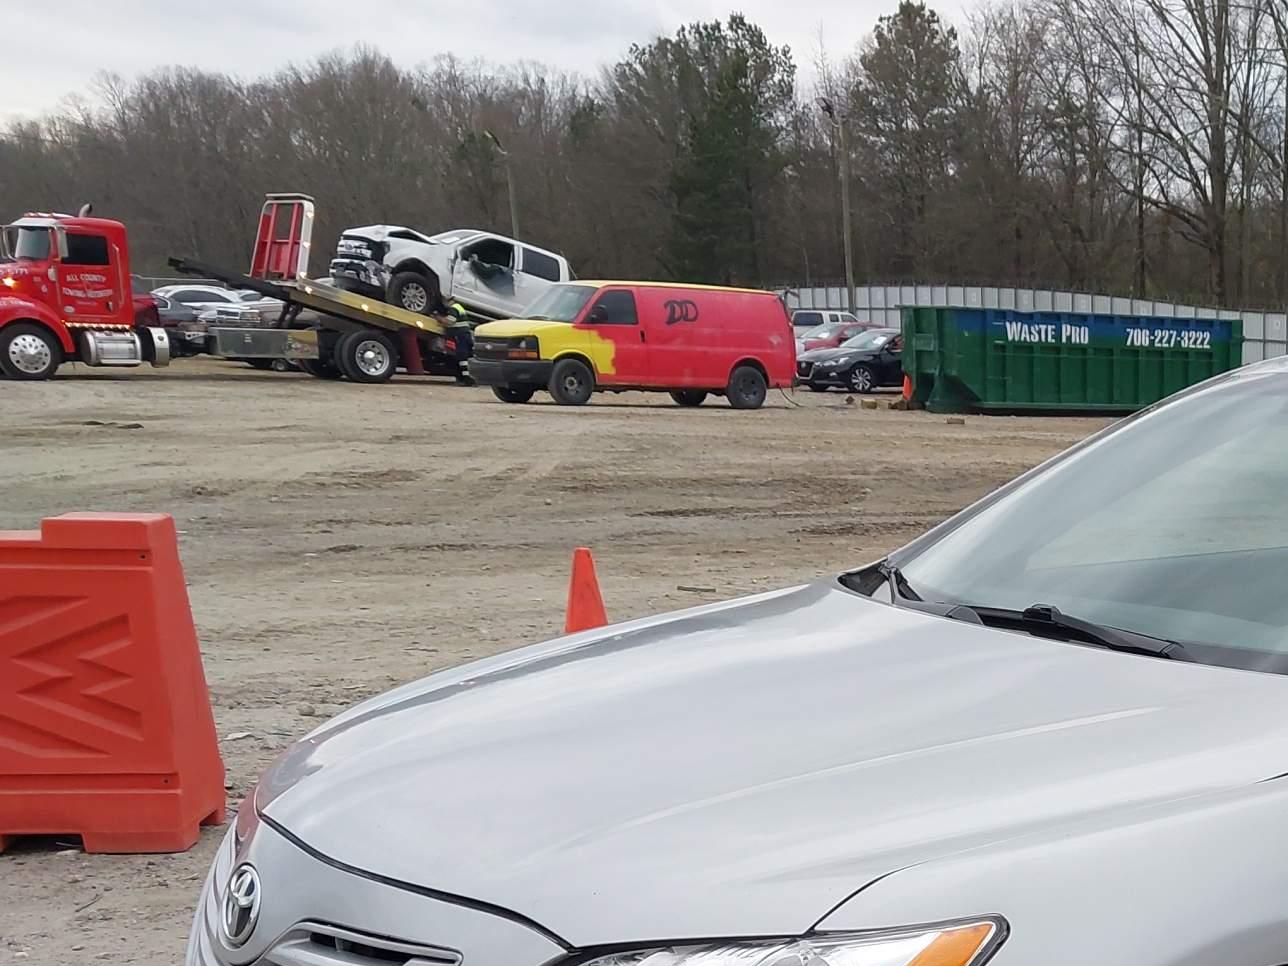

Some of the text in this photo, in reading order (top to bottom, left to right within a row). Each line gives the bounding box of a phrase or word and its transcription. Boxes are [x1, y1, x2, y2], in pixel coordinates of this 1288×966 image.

[1006, 321, 1089, 345] WASTE PRO
[1126, 328, 1211, 349] 706-227-3222
